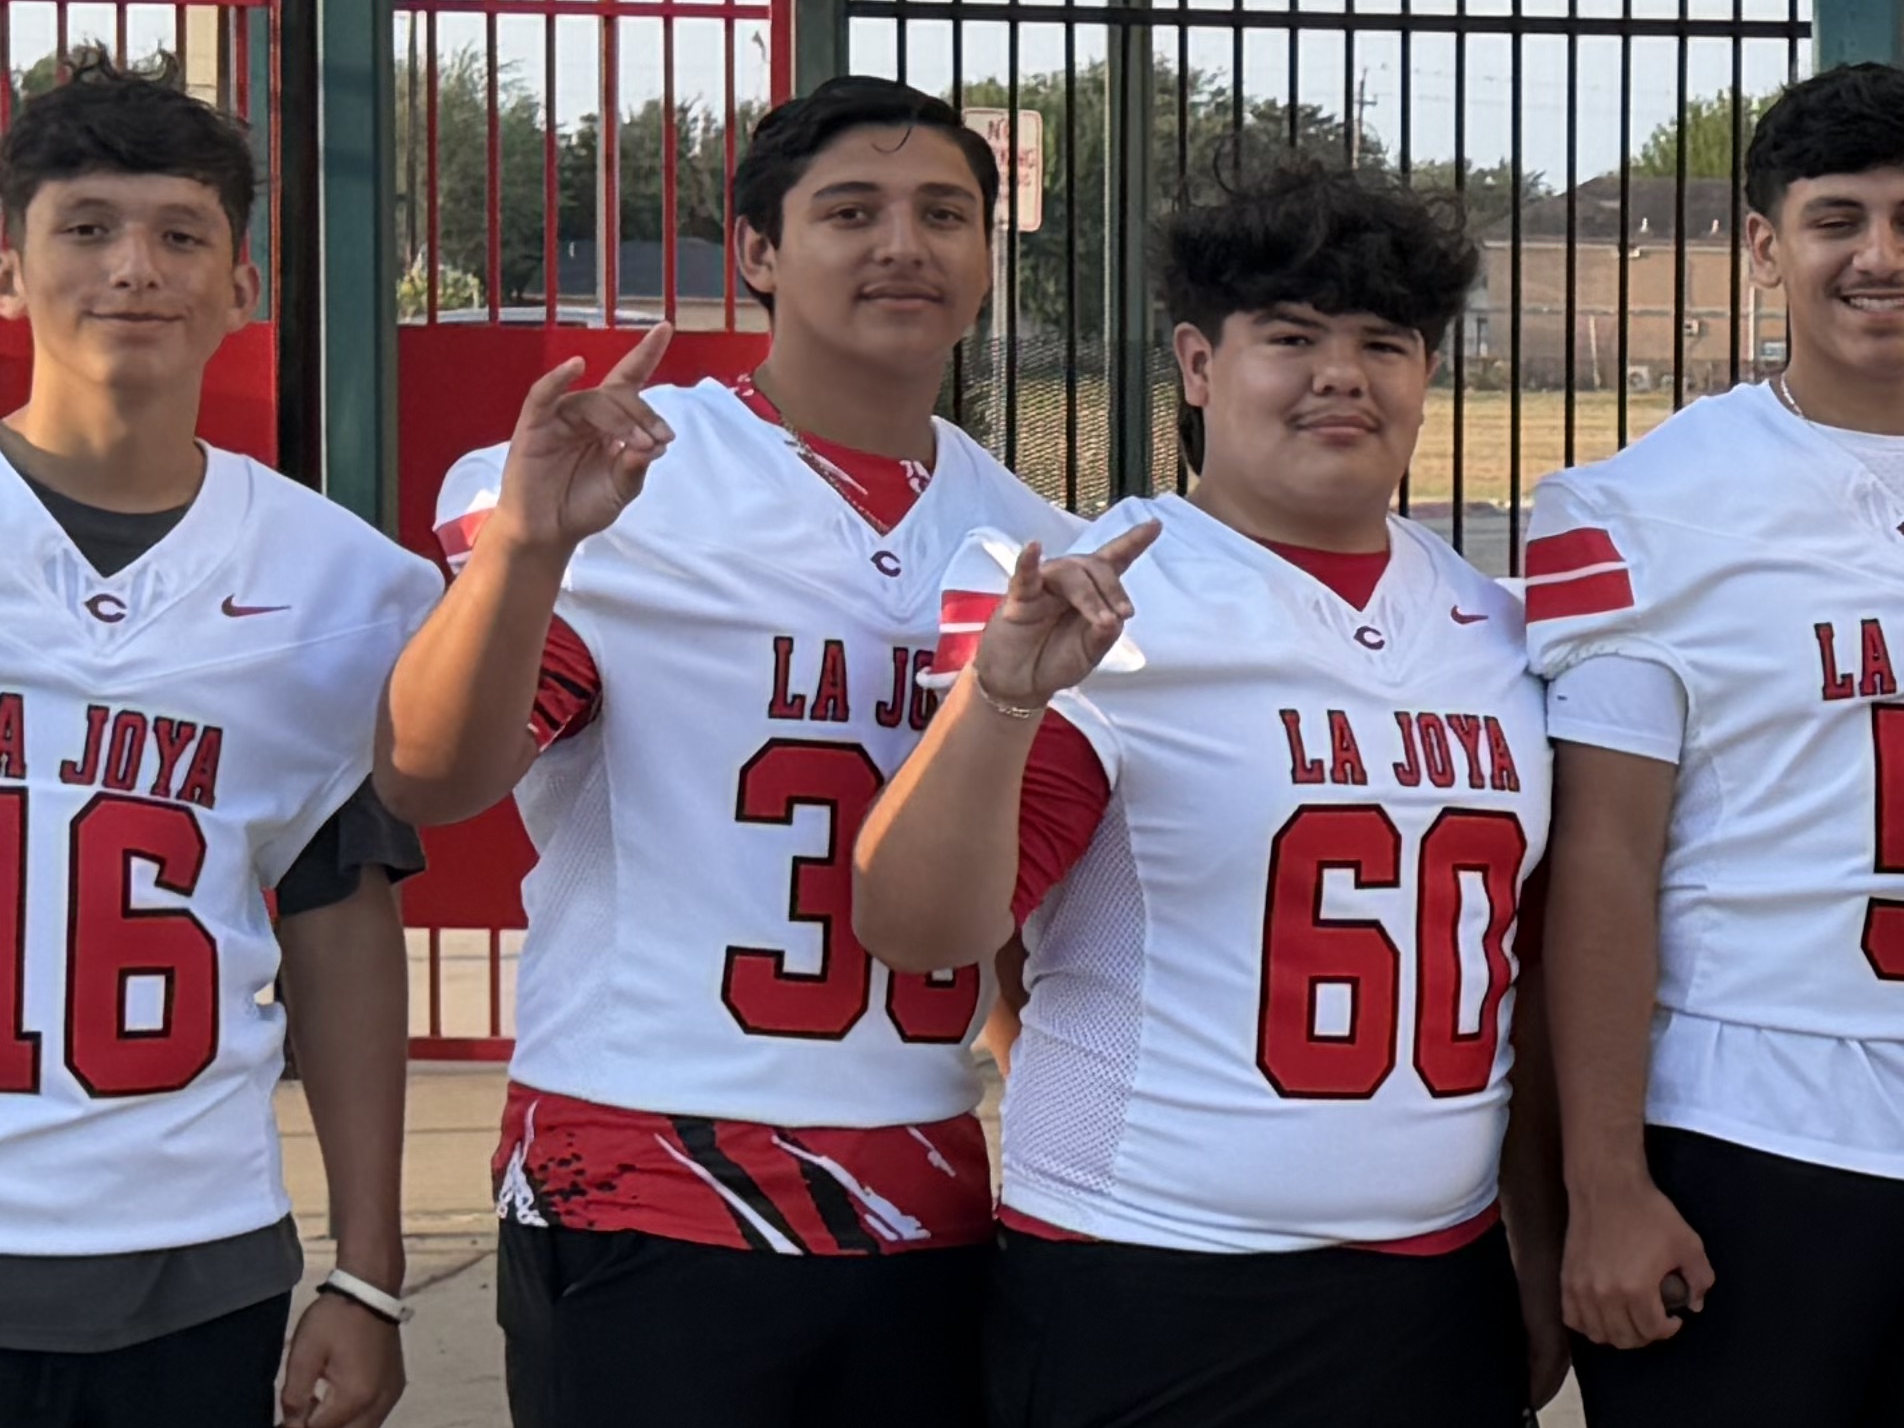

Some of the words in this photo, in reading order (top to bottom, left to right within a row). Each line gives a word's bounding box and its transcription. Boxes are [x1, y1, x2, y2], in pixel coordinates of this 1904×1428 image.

[870, 550, 902, 578] C
[84, 593, 127, 624] C
[1353, 625, 1386, 651] C
[768, 636, 849, 722] LA
[1813, 618, 1897, 701] LA
[0, 693, 26, 779] A
[60, 704, 223, 809] JOYA
[1279, 709, 1368, 785] LA
[1393, 711, 1521, 792] JOYA
[1256, 804, 1526, 1099] 60
